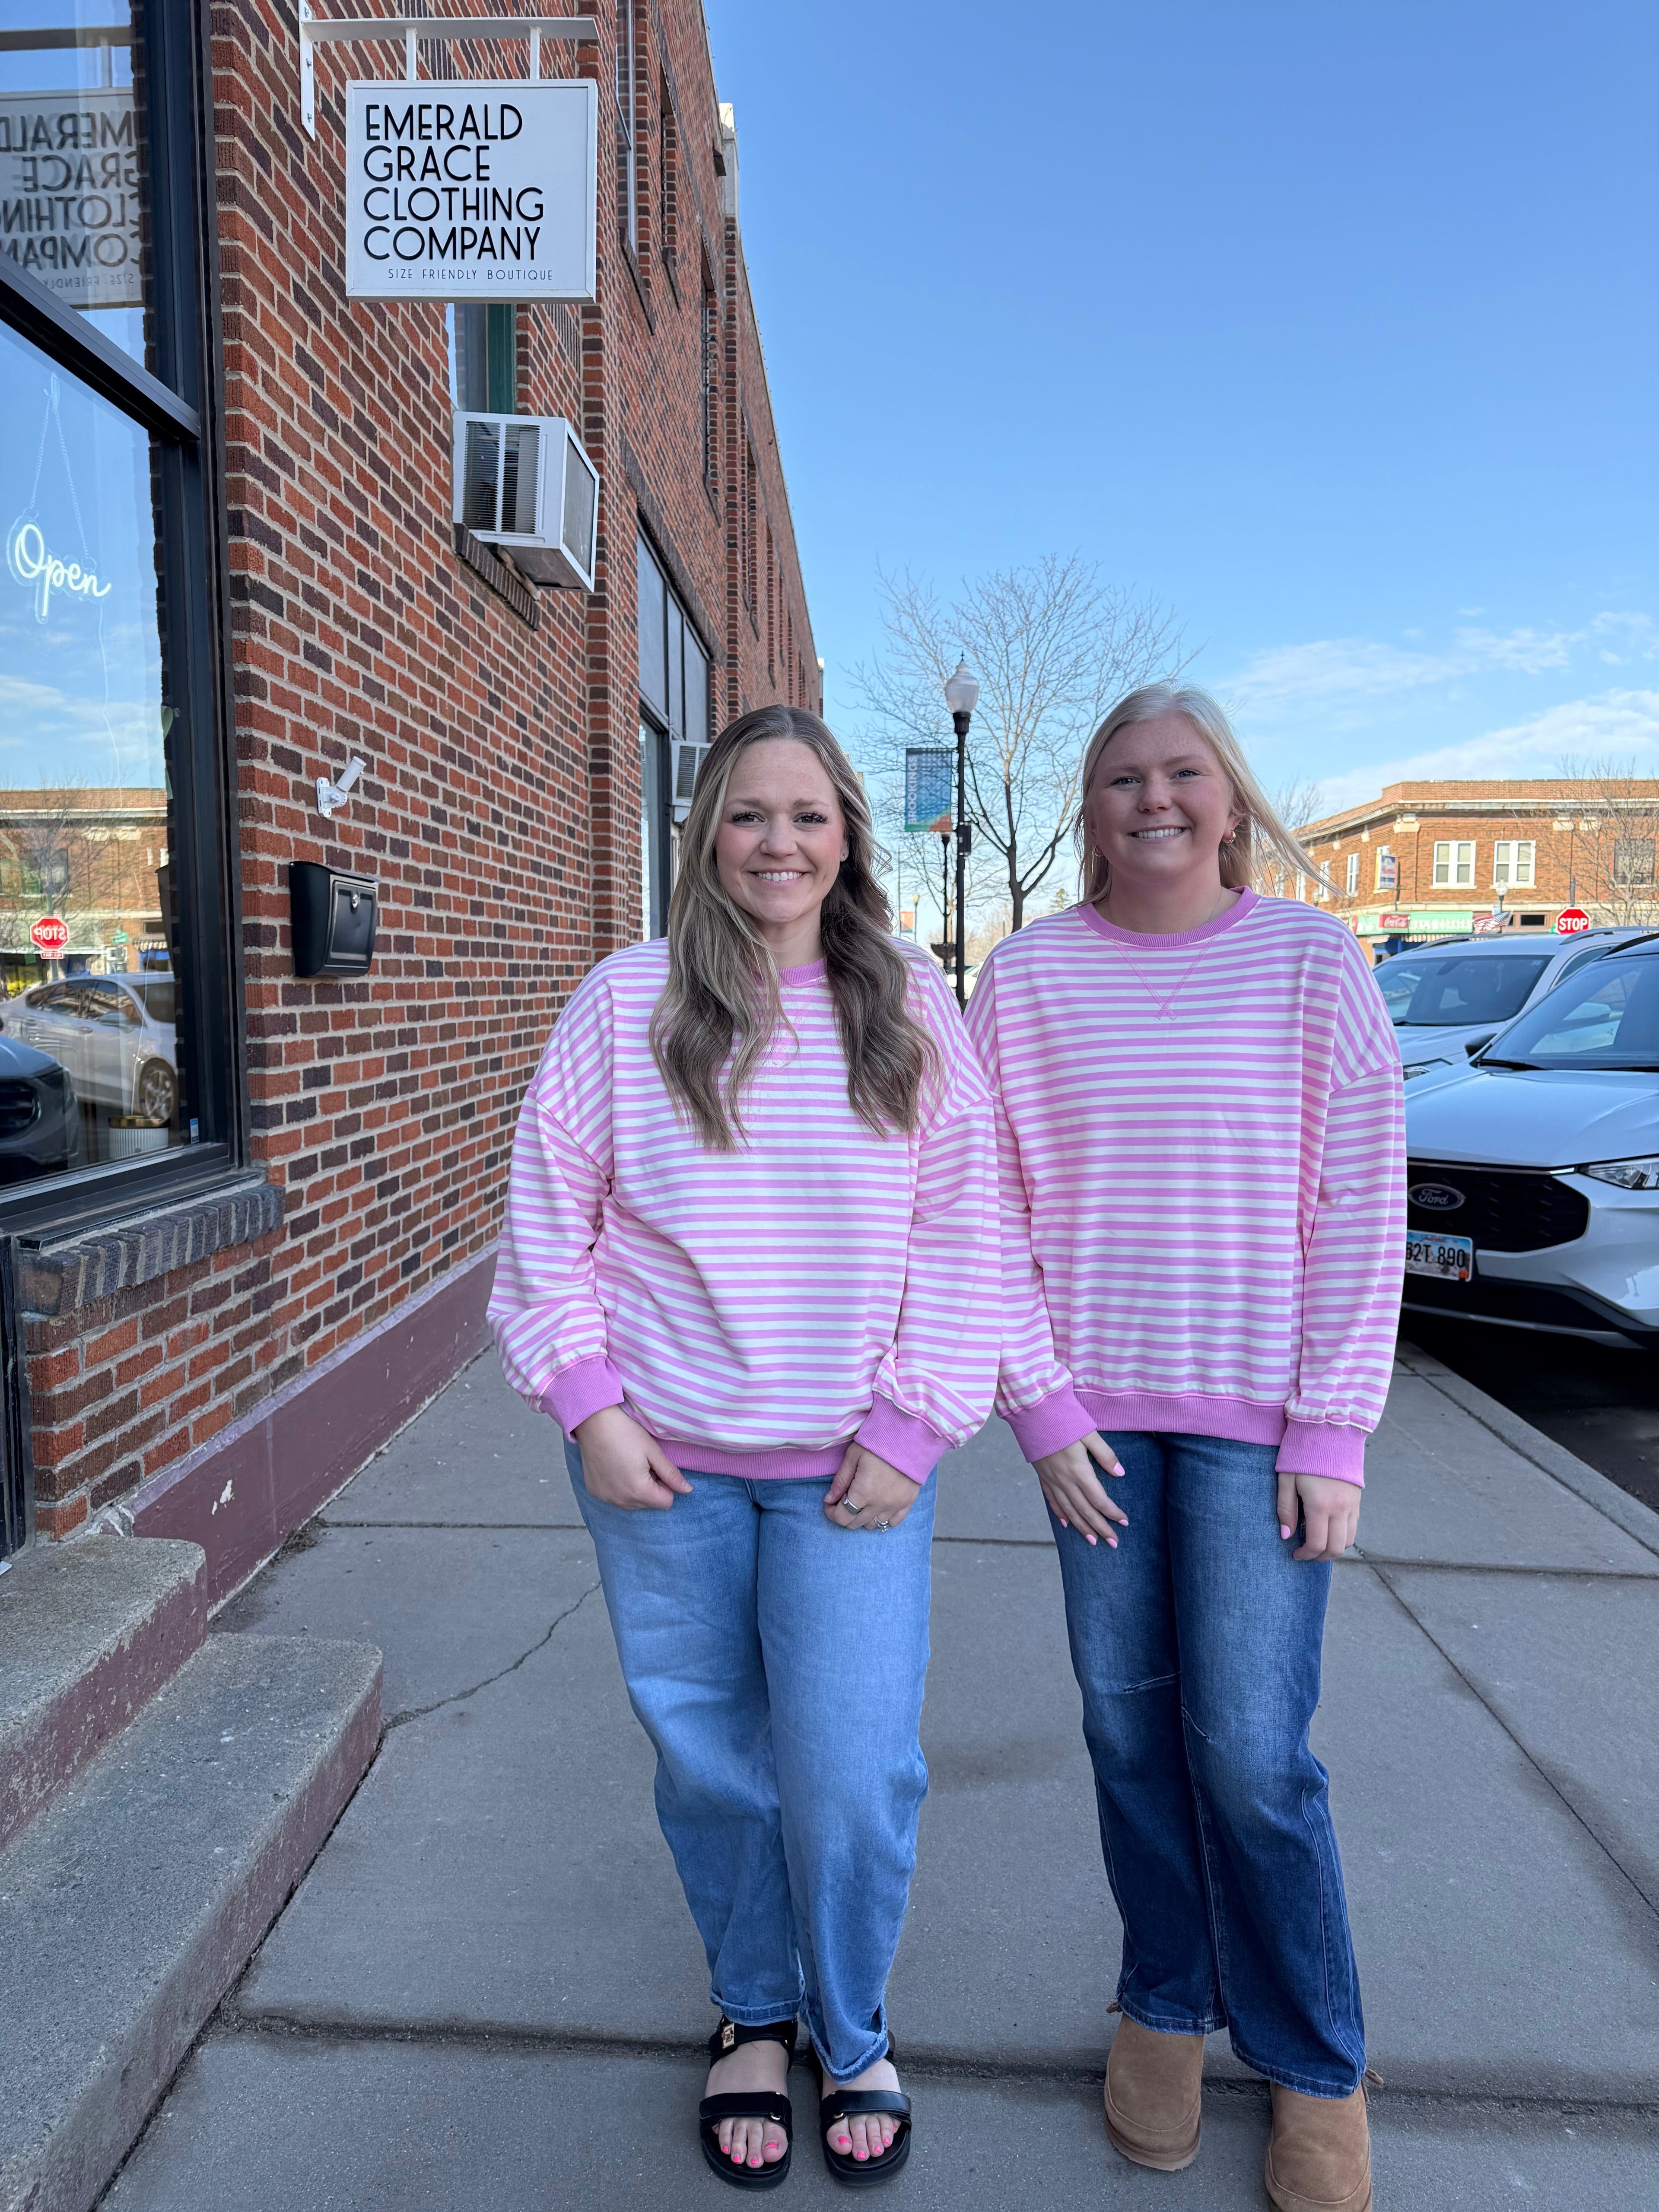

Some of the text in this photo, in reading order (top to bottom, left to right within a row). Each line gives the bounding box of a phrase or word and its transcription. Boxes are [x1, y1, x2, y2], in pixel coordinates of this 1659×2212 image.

[365, 104, 523, 140] EMERALD
[363, 145, 490, 181] GRACE
[364, 187, 544, 222] CLOTHING
[363, 226, 541, 261] COMPANY
[388, 268, 553, 280] SIZE FRIENDLY BOUTIQUE
[15, 524, 112, 617] Open
[908, 756, 918, 824] BROOKINGS
[1559, 917, 1588, 931] STOP
[1418, 1188, 1448, 1205] Ford
[1437, 1246, 1465, 1268] 890
